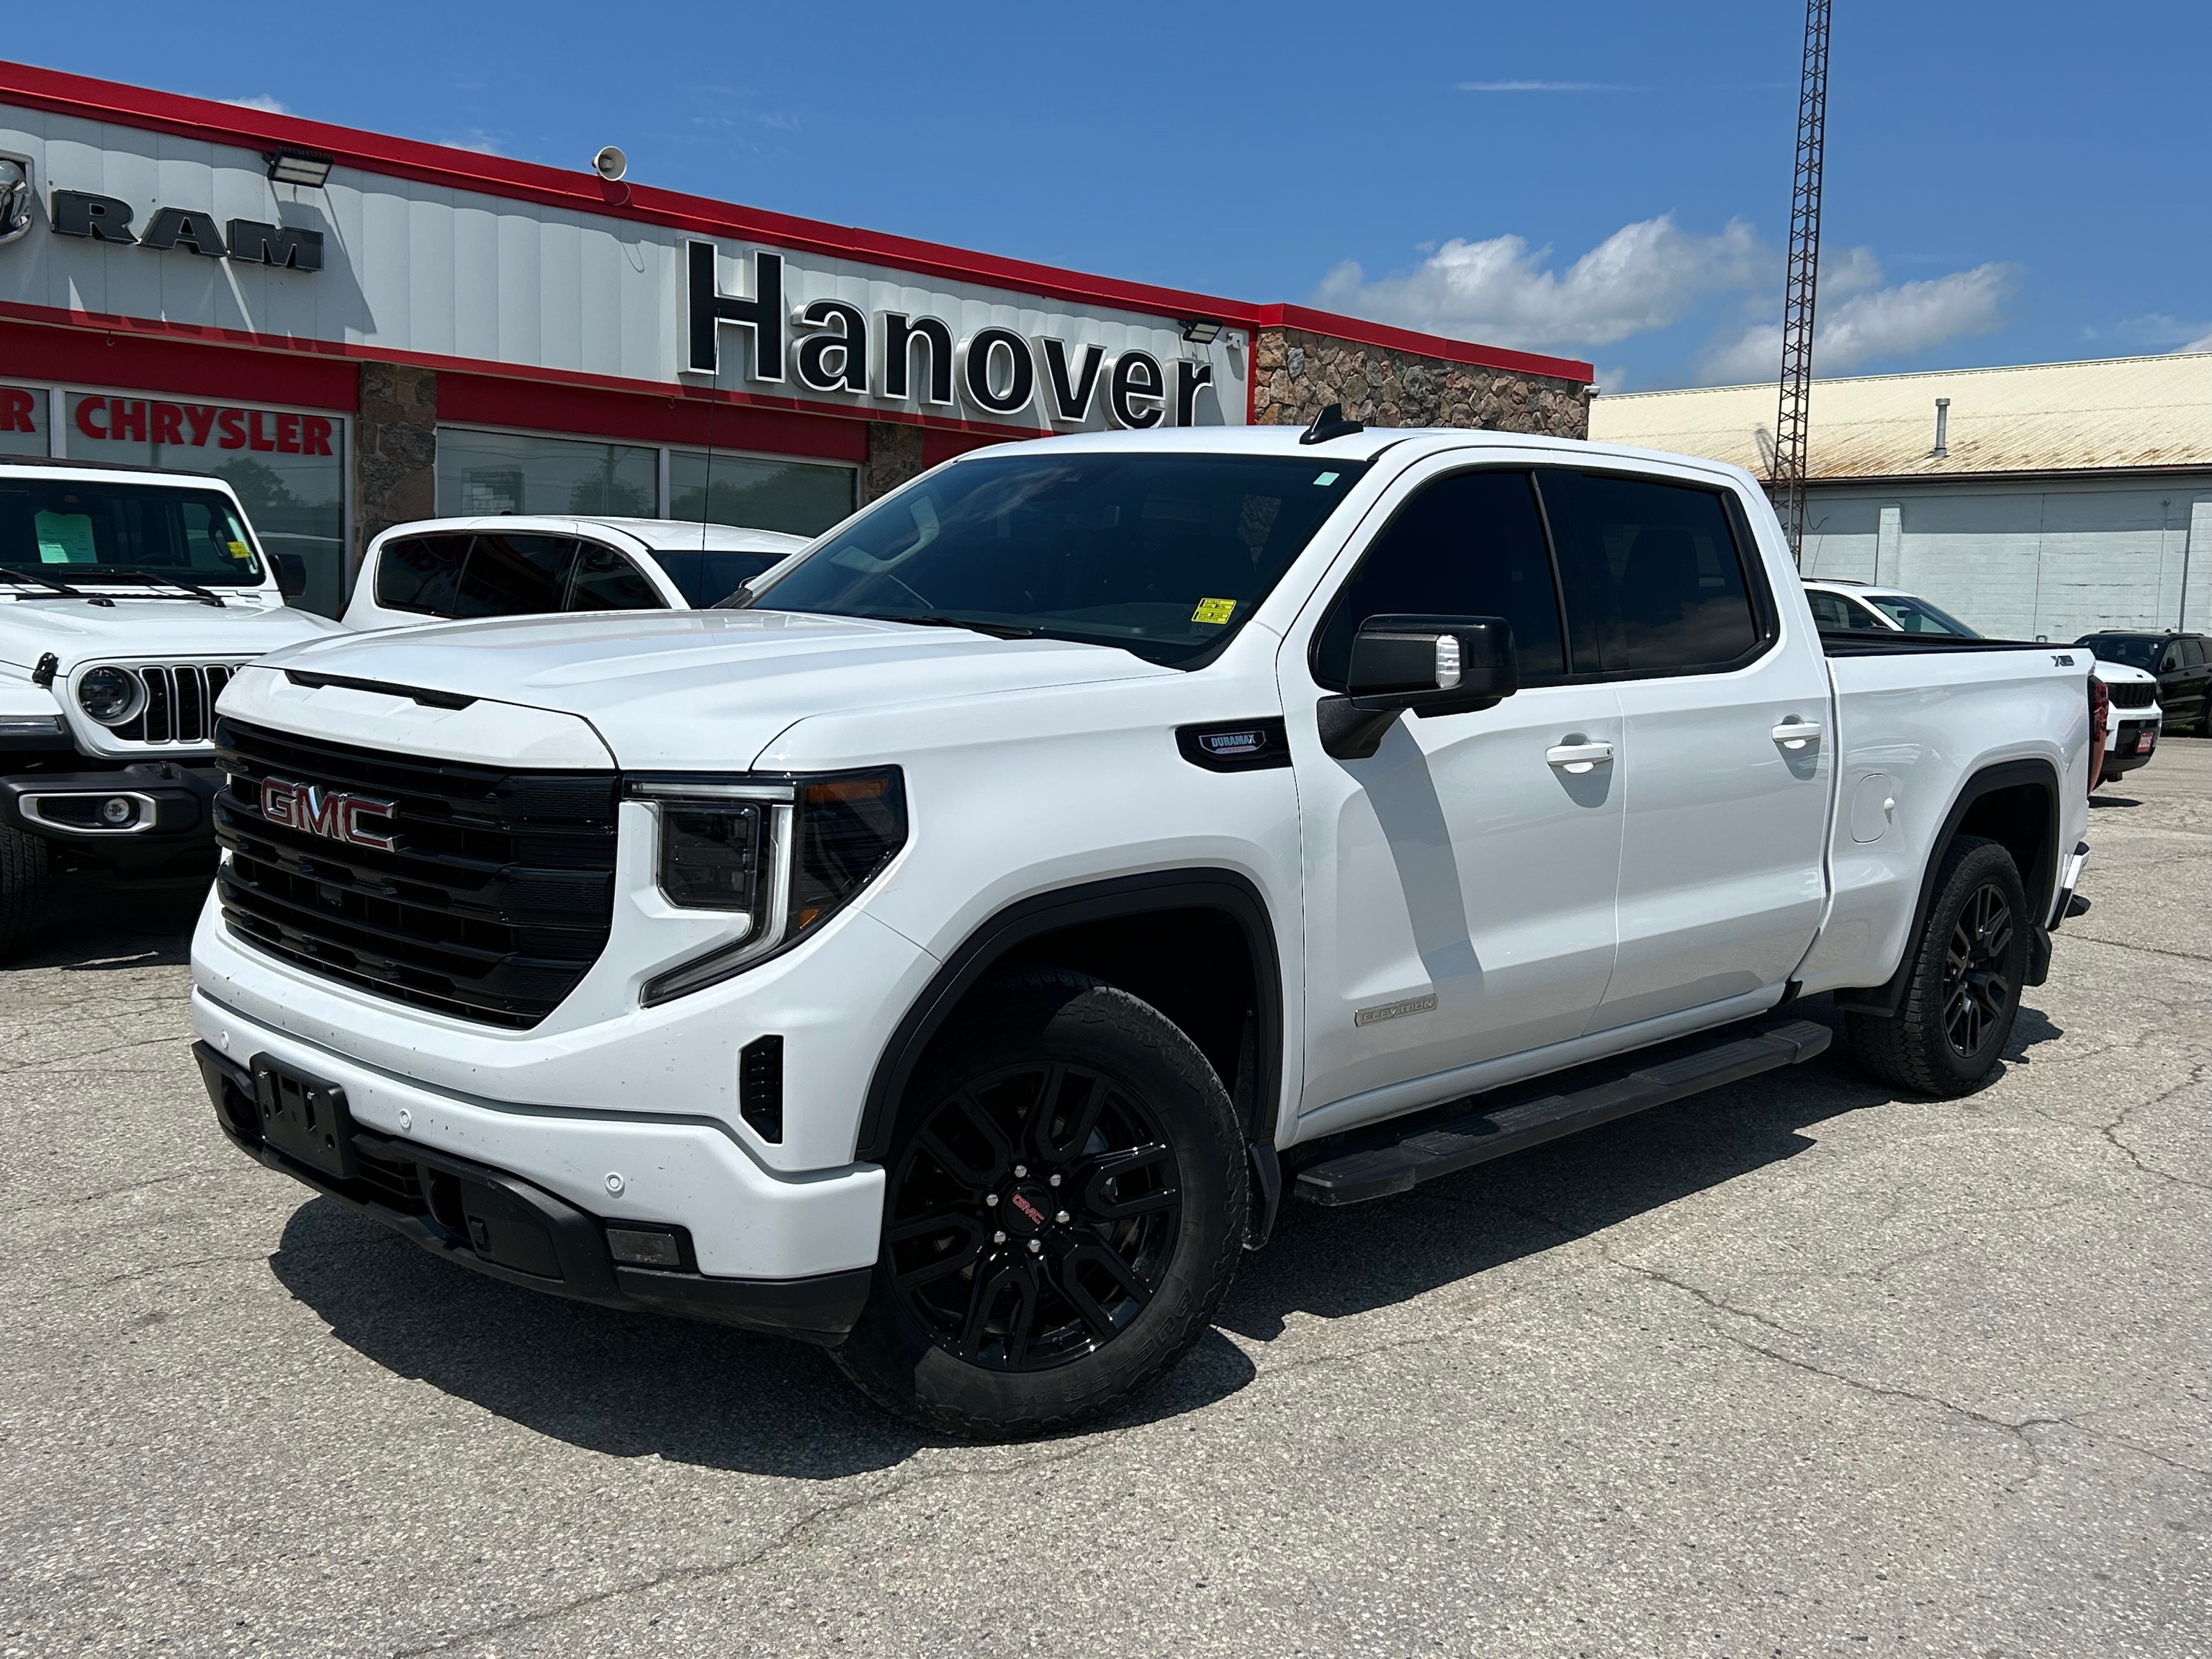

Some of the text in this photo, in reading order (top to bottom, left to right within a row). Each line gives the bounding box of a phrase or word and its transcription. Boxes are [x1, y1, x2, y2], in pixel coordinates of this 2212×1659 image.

[51, 189, 324, 272] RAM
[678, 236, 1213, 430] Hanover
[75, 396, 333, 457] CHRYSLER
[1210, 734, 1256, 747] DURAMAX
[261, 775, 396, 853] GMC
[1363, 1000, 1433, 1021] ELEVATION
[1012, 1194, 1044, 1225] GMC
[1062, 1287, 1194, 1403] DUELER
